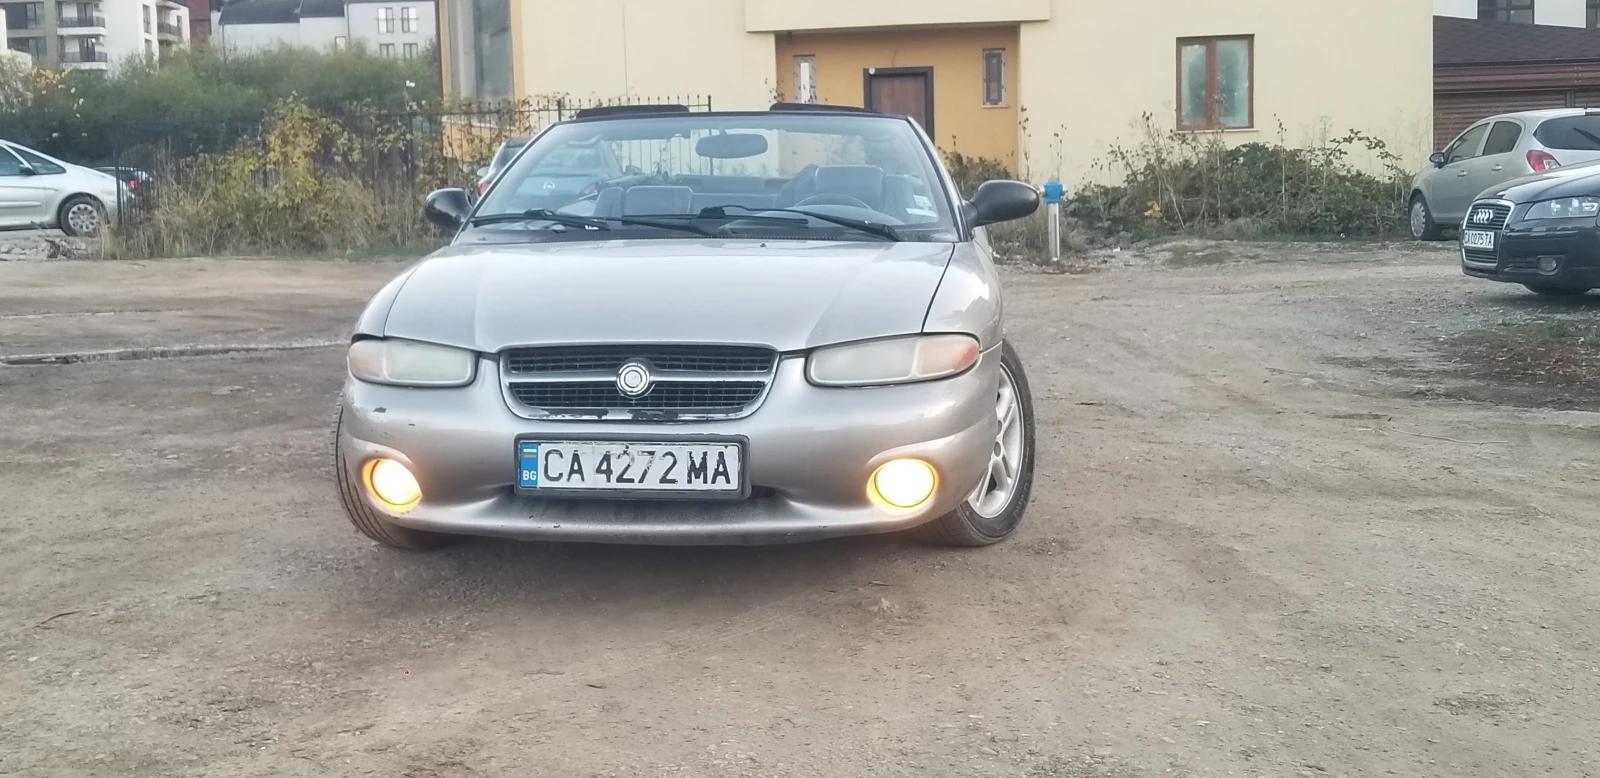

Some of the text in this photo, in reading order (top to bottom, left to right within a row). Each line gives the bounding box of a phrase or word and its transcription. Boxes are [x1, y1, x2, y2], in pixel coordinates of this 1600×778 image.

[522, 470, 537, 481] BG
[543, 448, 732, 485] CA 4272 MA
